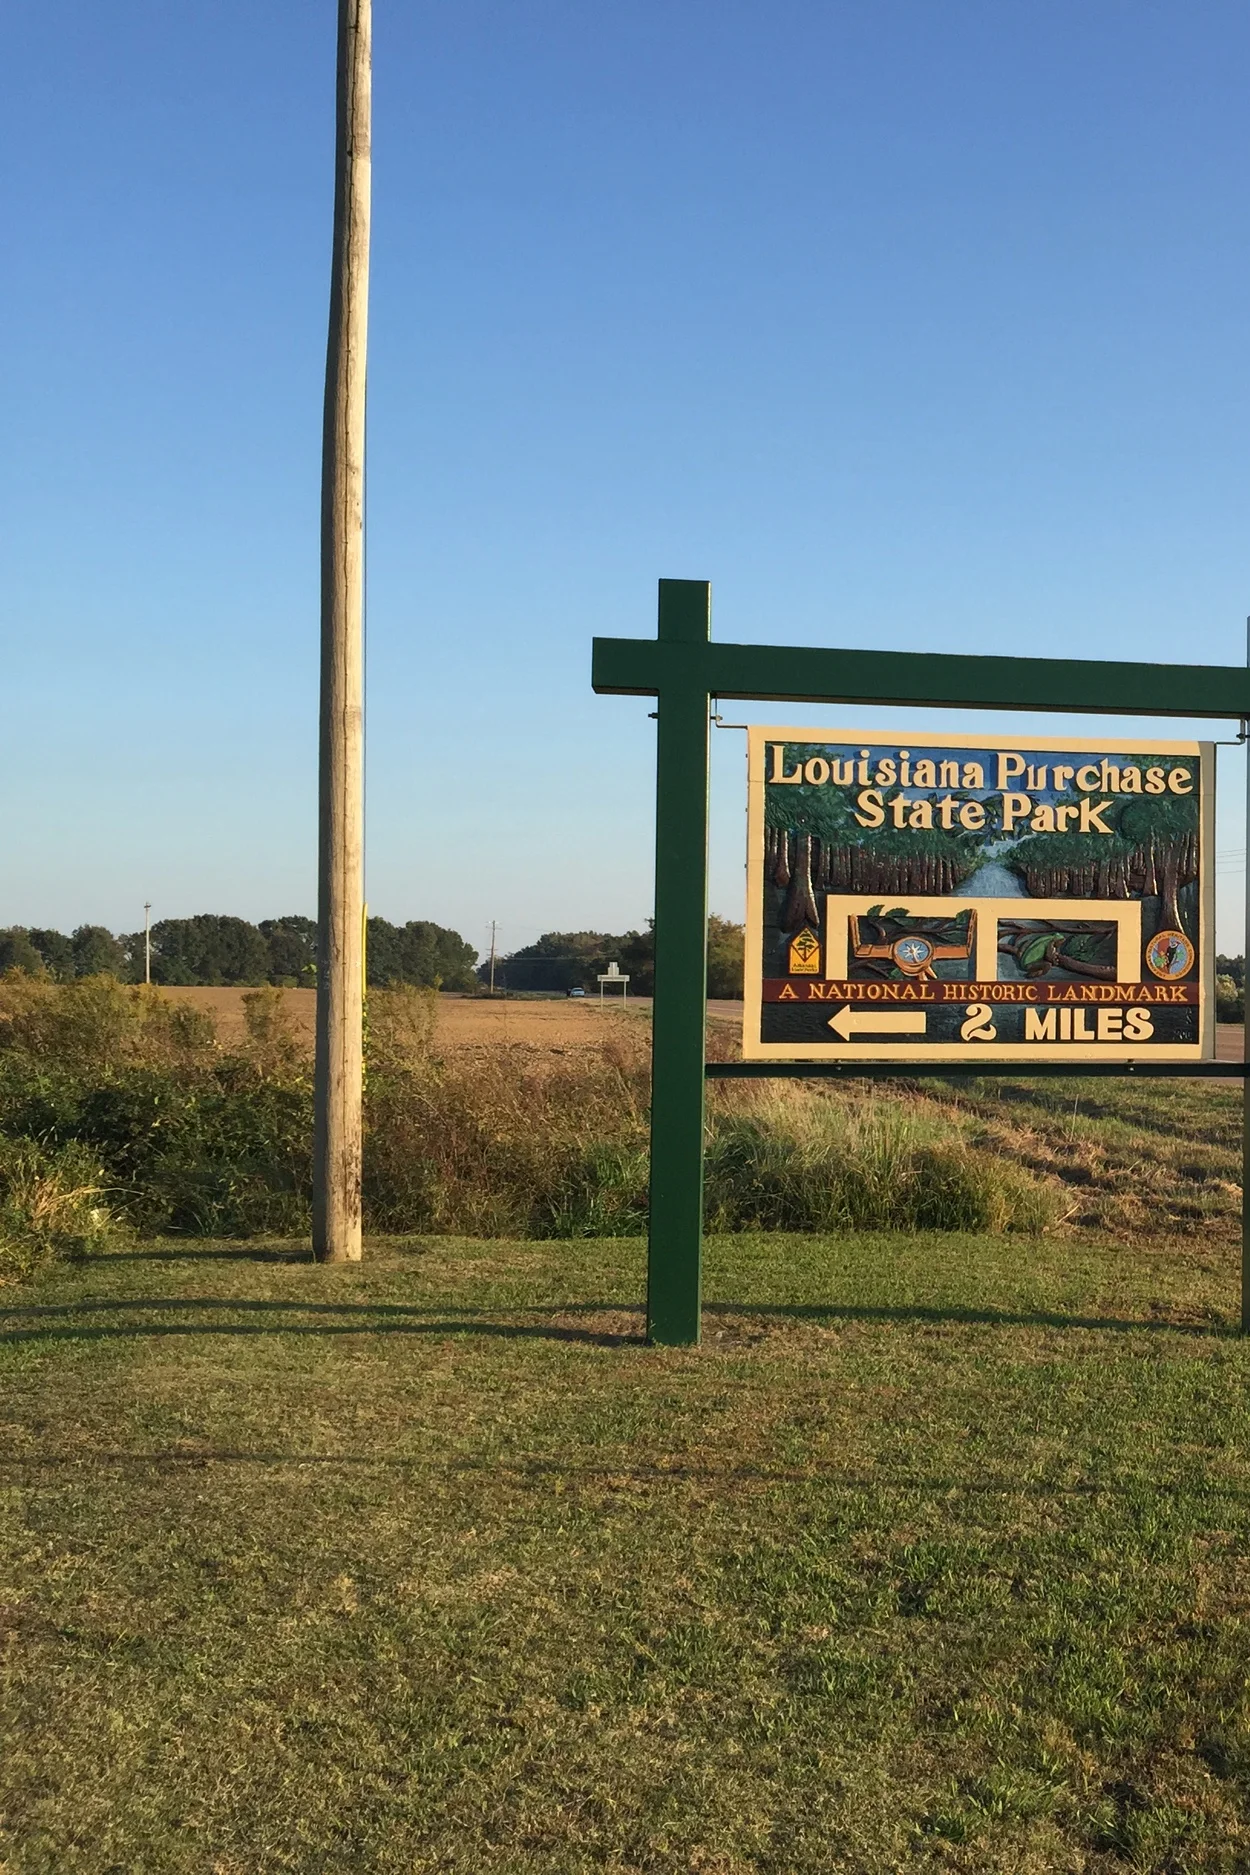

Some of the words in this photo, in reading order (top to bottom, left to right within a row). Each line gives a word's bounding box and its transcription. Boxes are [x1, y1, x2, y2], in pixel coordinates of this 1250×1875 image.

[769, 745, 984, 789] Louisiana
[995, 752, 1193, 795] Purchase
[854, 789, 986, 830] State
[778, 983, 799, 999] A
[808, 983, 935, 1000] NATIONAL
[942, 984, 1038, 1001] HISTORIC
[1047, 985, 1188, 1002] LANDMARK
[960, 1003, 997, 1041] 2
[1025, 1007, 1155, 1041] MILES
